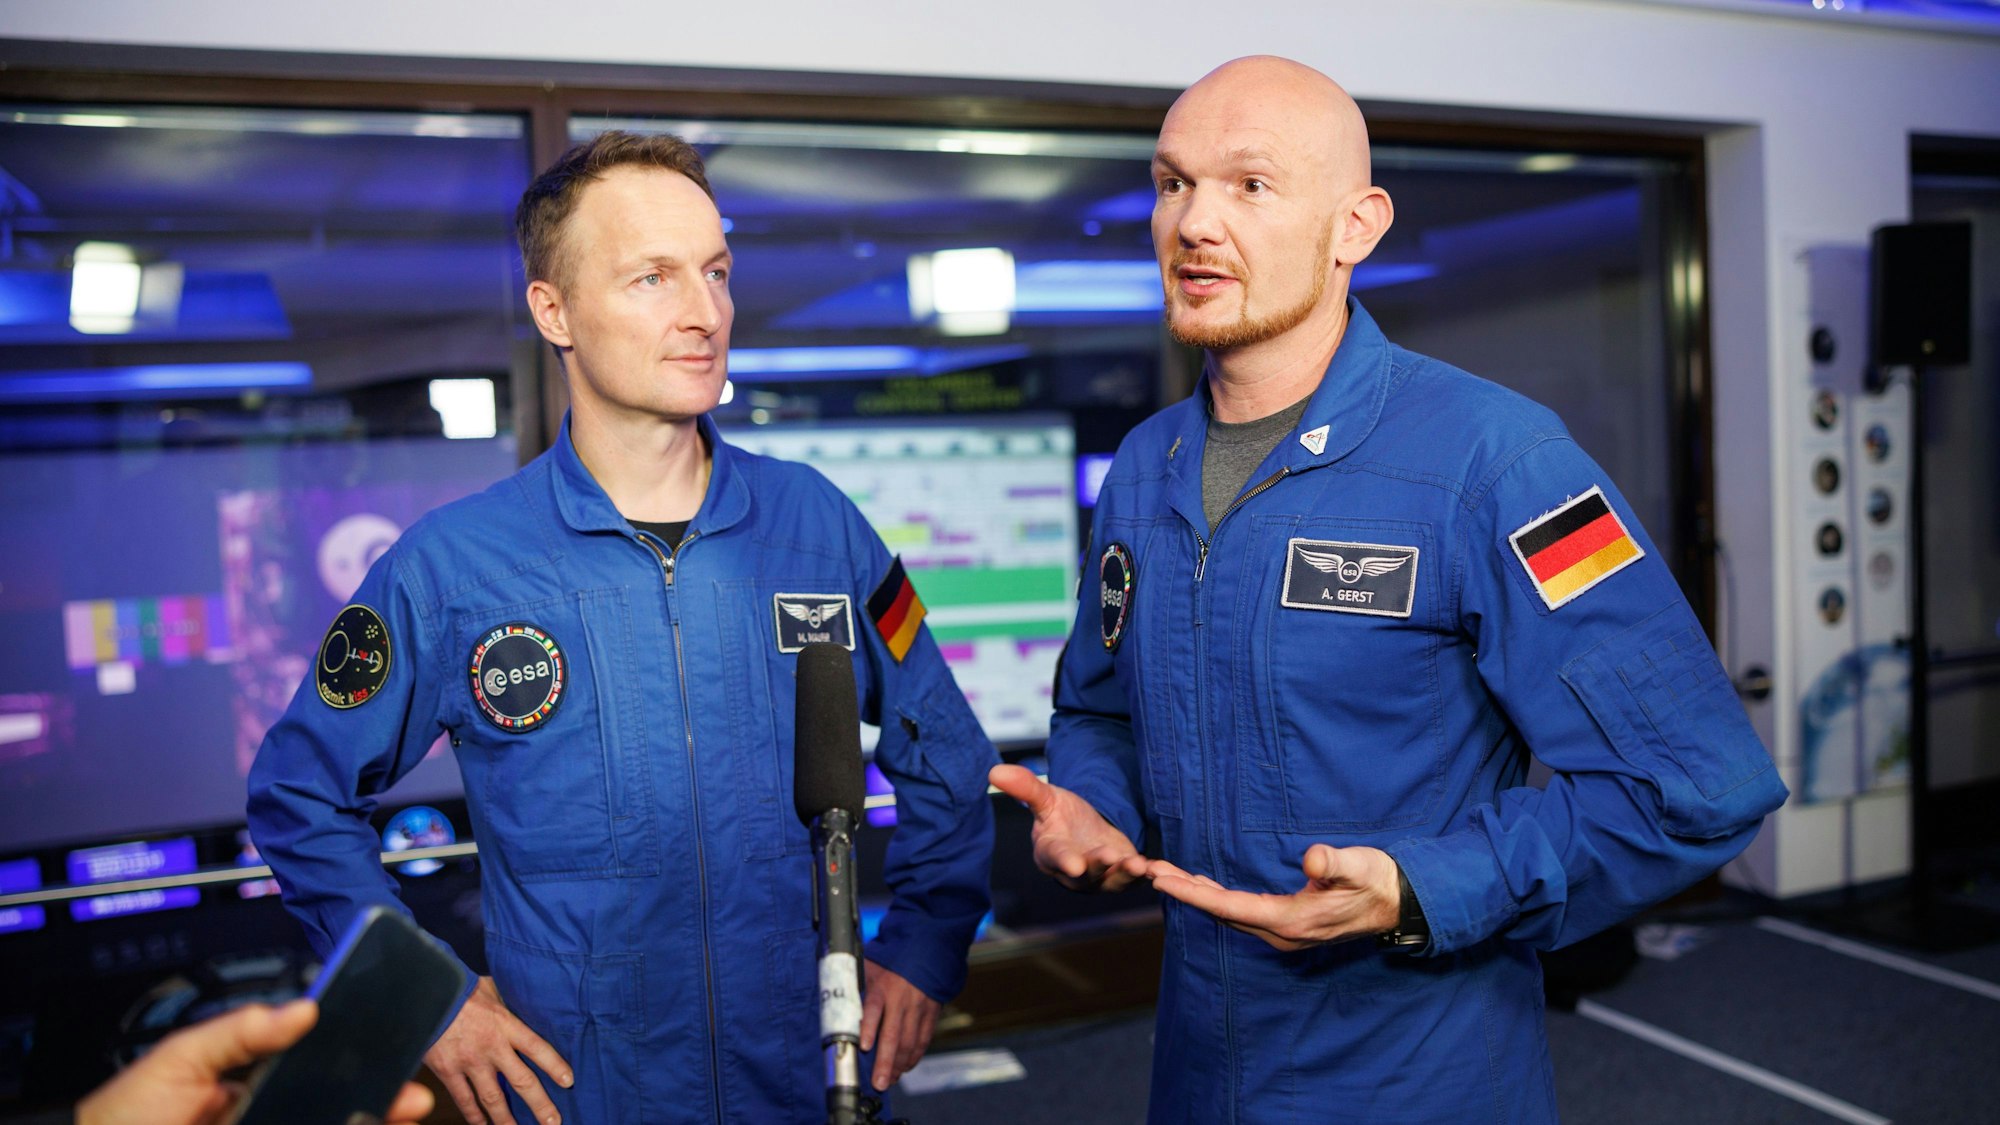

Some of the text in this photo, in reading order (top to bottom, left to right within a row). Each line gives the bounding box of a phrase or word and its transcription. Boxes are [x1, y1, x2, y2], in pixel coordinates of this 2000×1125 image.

[1321, 587, 1375, 604] A. GERST
[509, 661, 550, 685] esa
[321, 682, 369, 705] cosmic kiss
